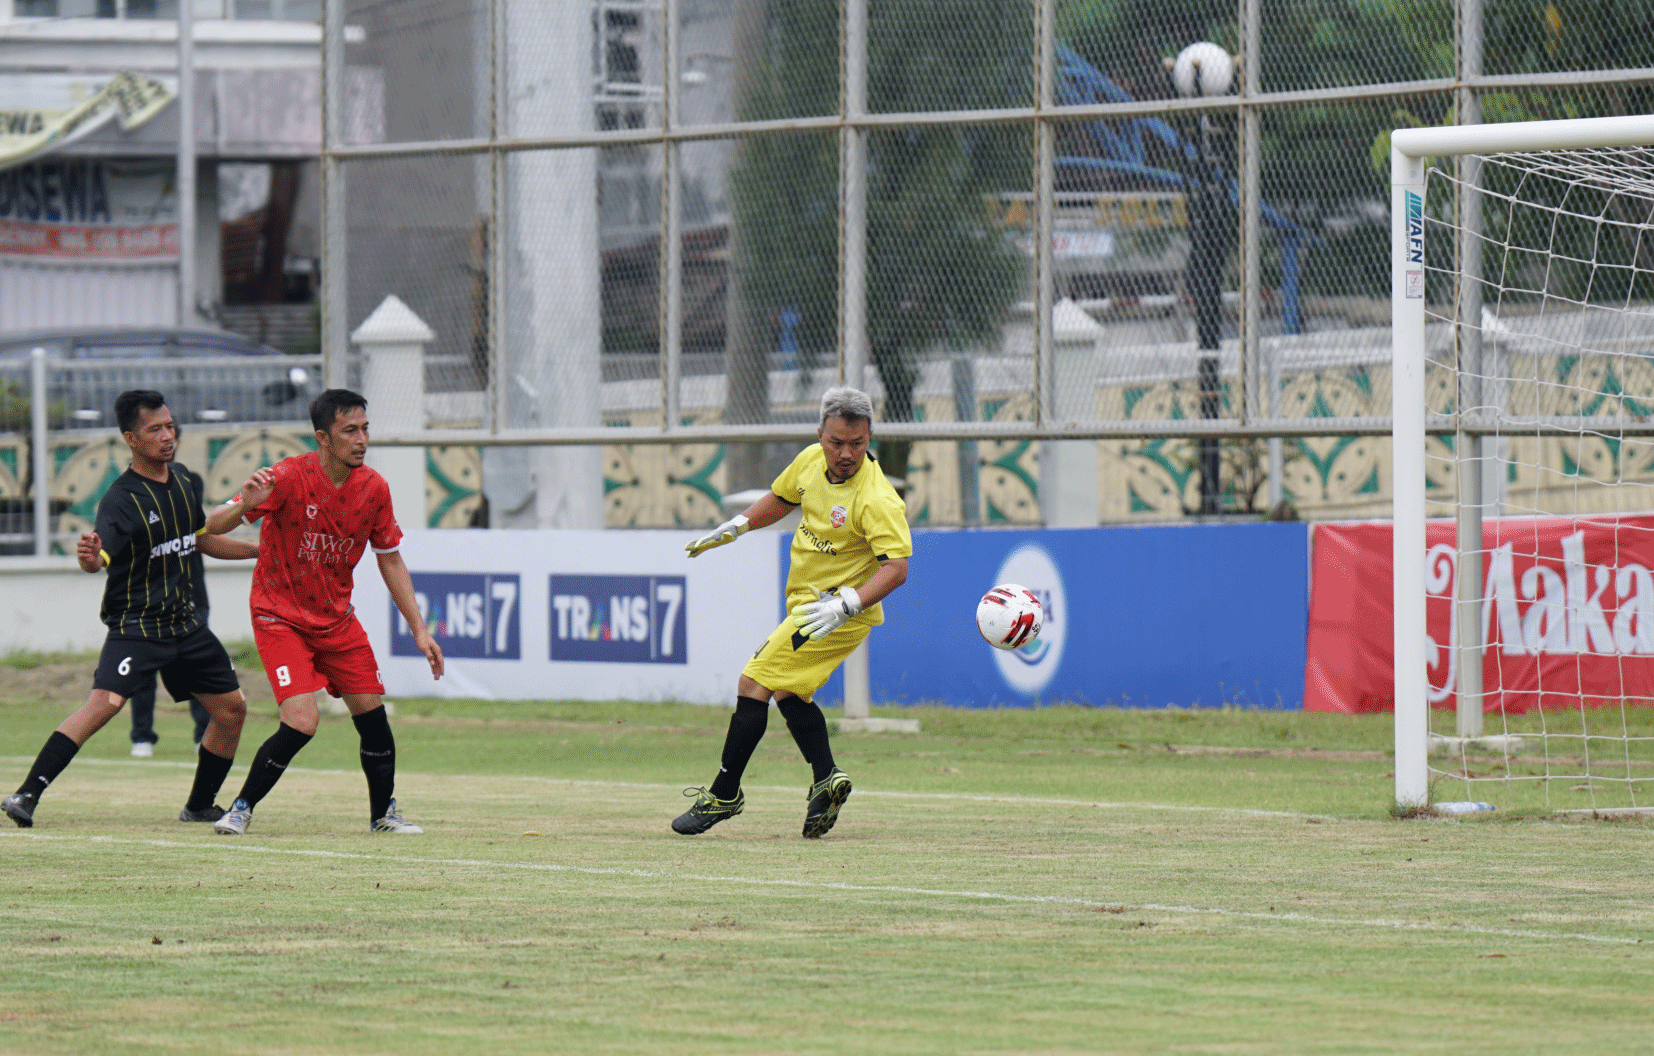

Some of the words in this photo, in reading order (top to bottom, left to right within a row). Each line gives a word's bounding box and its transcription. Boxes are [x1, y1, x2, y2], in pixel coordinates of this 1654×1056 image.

[1410, 223, 1423, 263] AFN
[150, 538, 182, 559] SIWO
[300, 531, 354, 555] SIWO
[492, 582, 517, 652] 7
[553, 594, 649, 642] TRANS
[657, 584, 683, 657] 7
[118, 657, 131, 676] 6
[276, 665, 291, 687] 9
